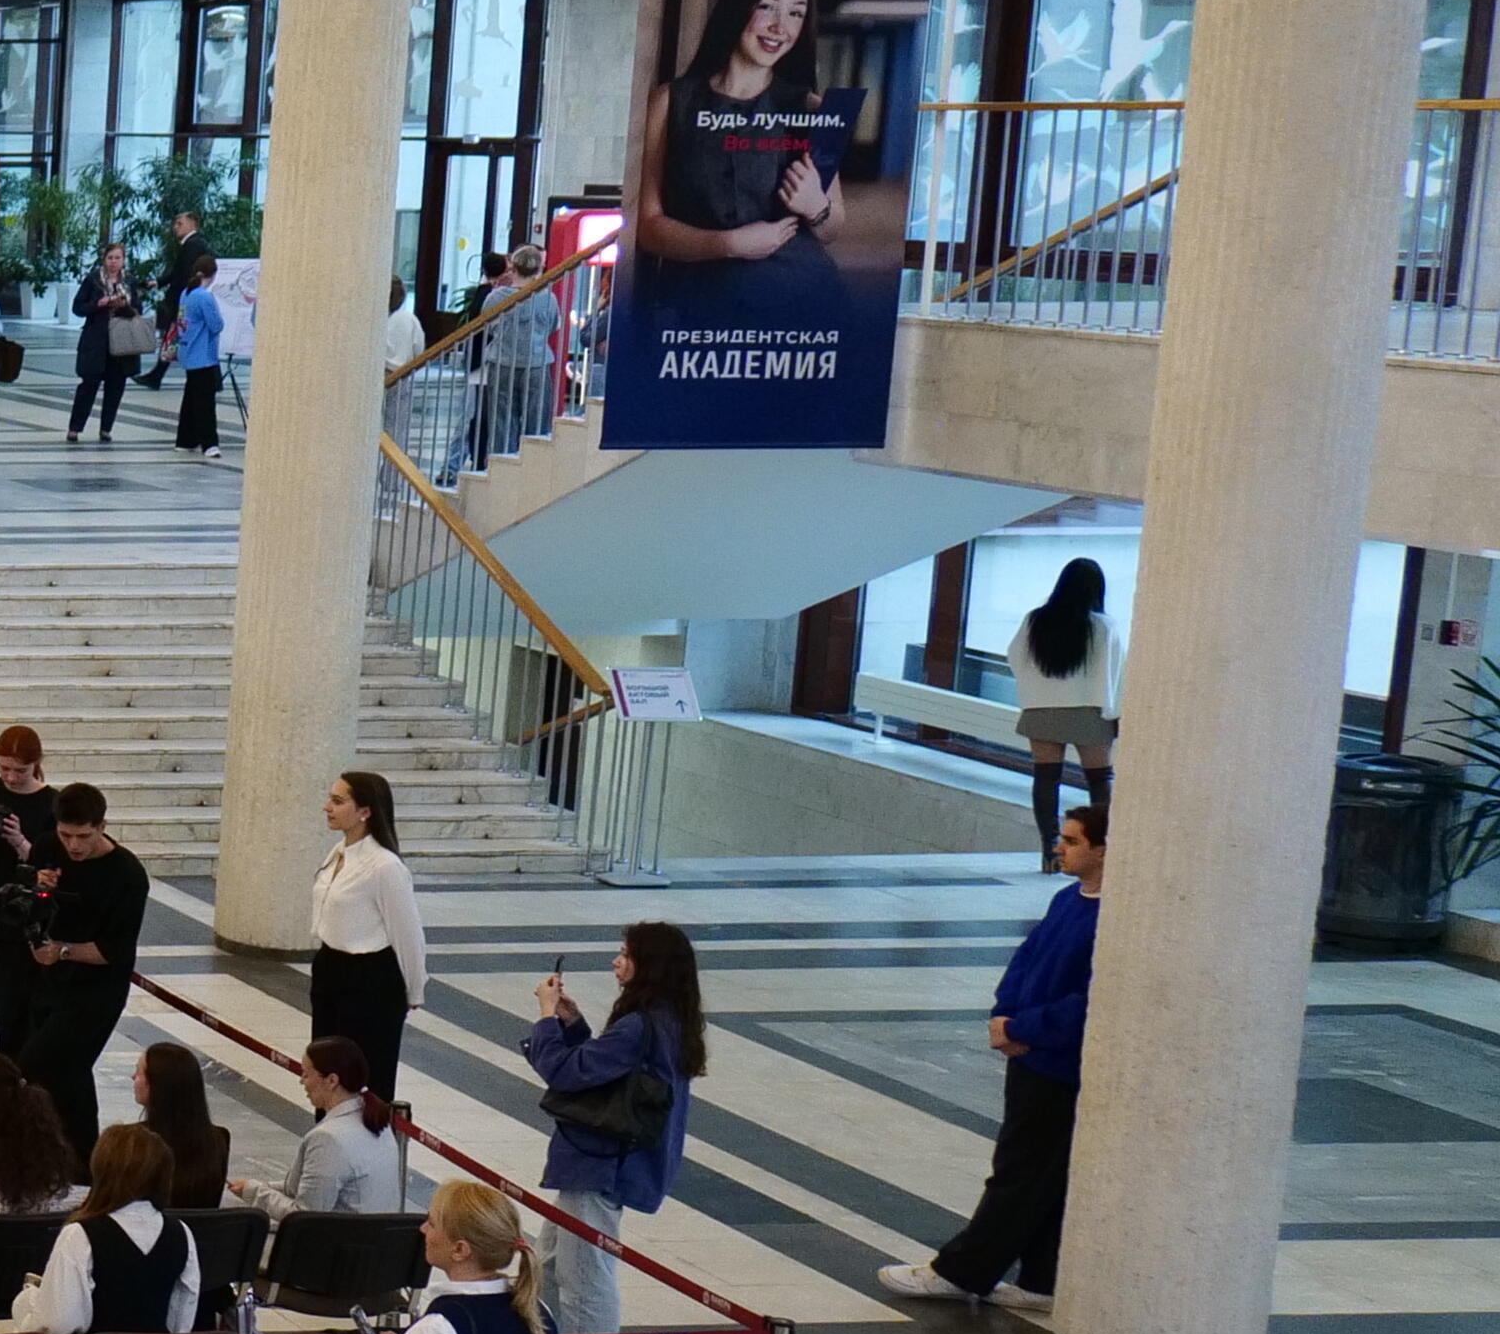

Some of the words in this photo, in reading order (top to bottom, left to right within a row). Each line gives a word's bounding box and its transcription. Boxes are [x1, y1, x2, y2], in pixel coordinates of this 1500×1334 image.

[696, 110, 748, 131] Будь
[752, 111, 847, 131] лучшим.
[723, 134, 751, 152] Во
[661, 329, 840, 345] ПРЕЗИДЕНТСКАЯ
[659, 351, 837, 379] АКАДЕМИЯ
